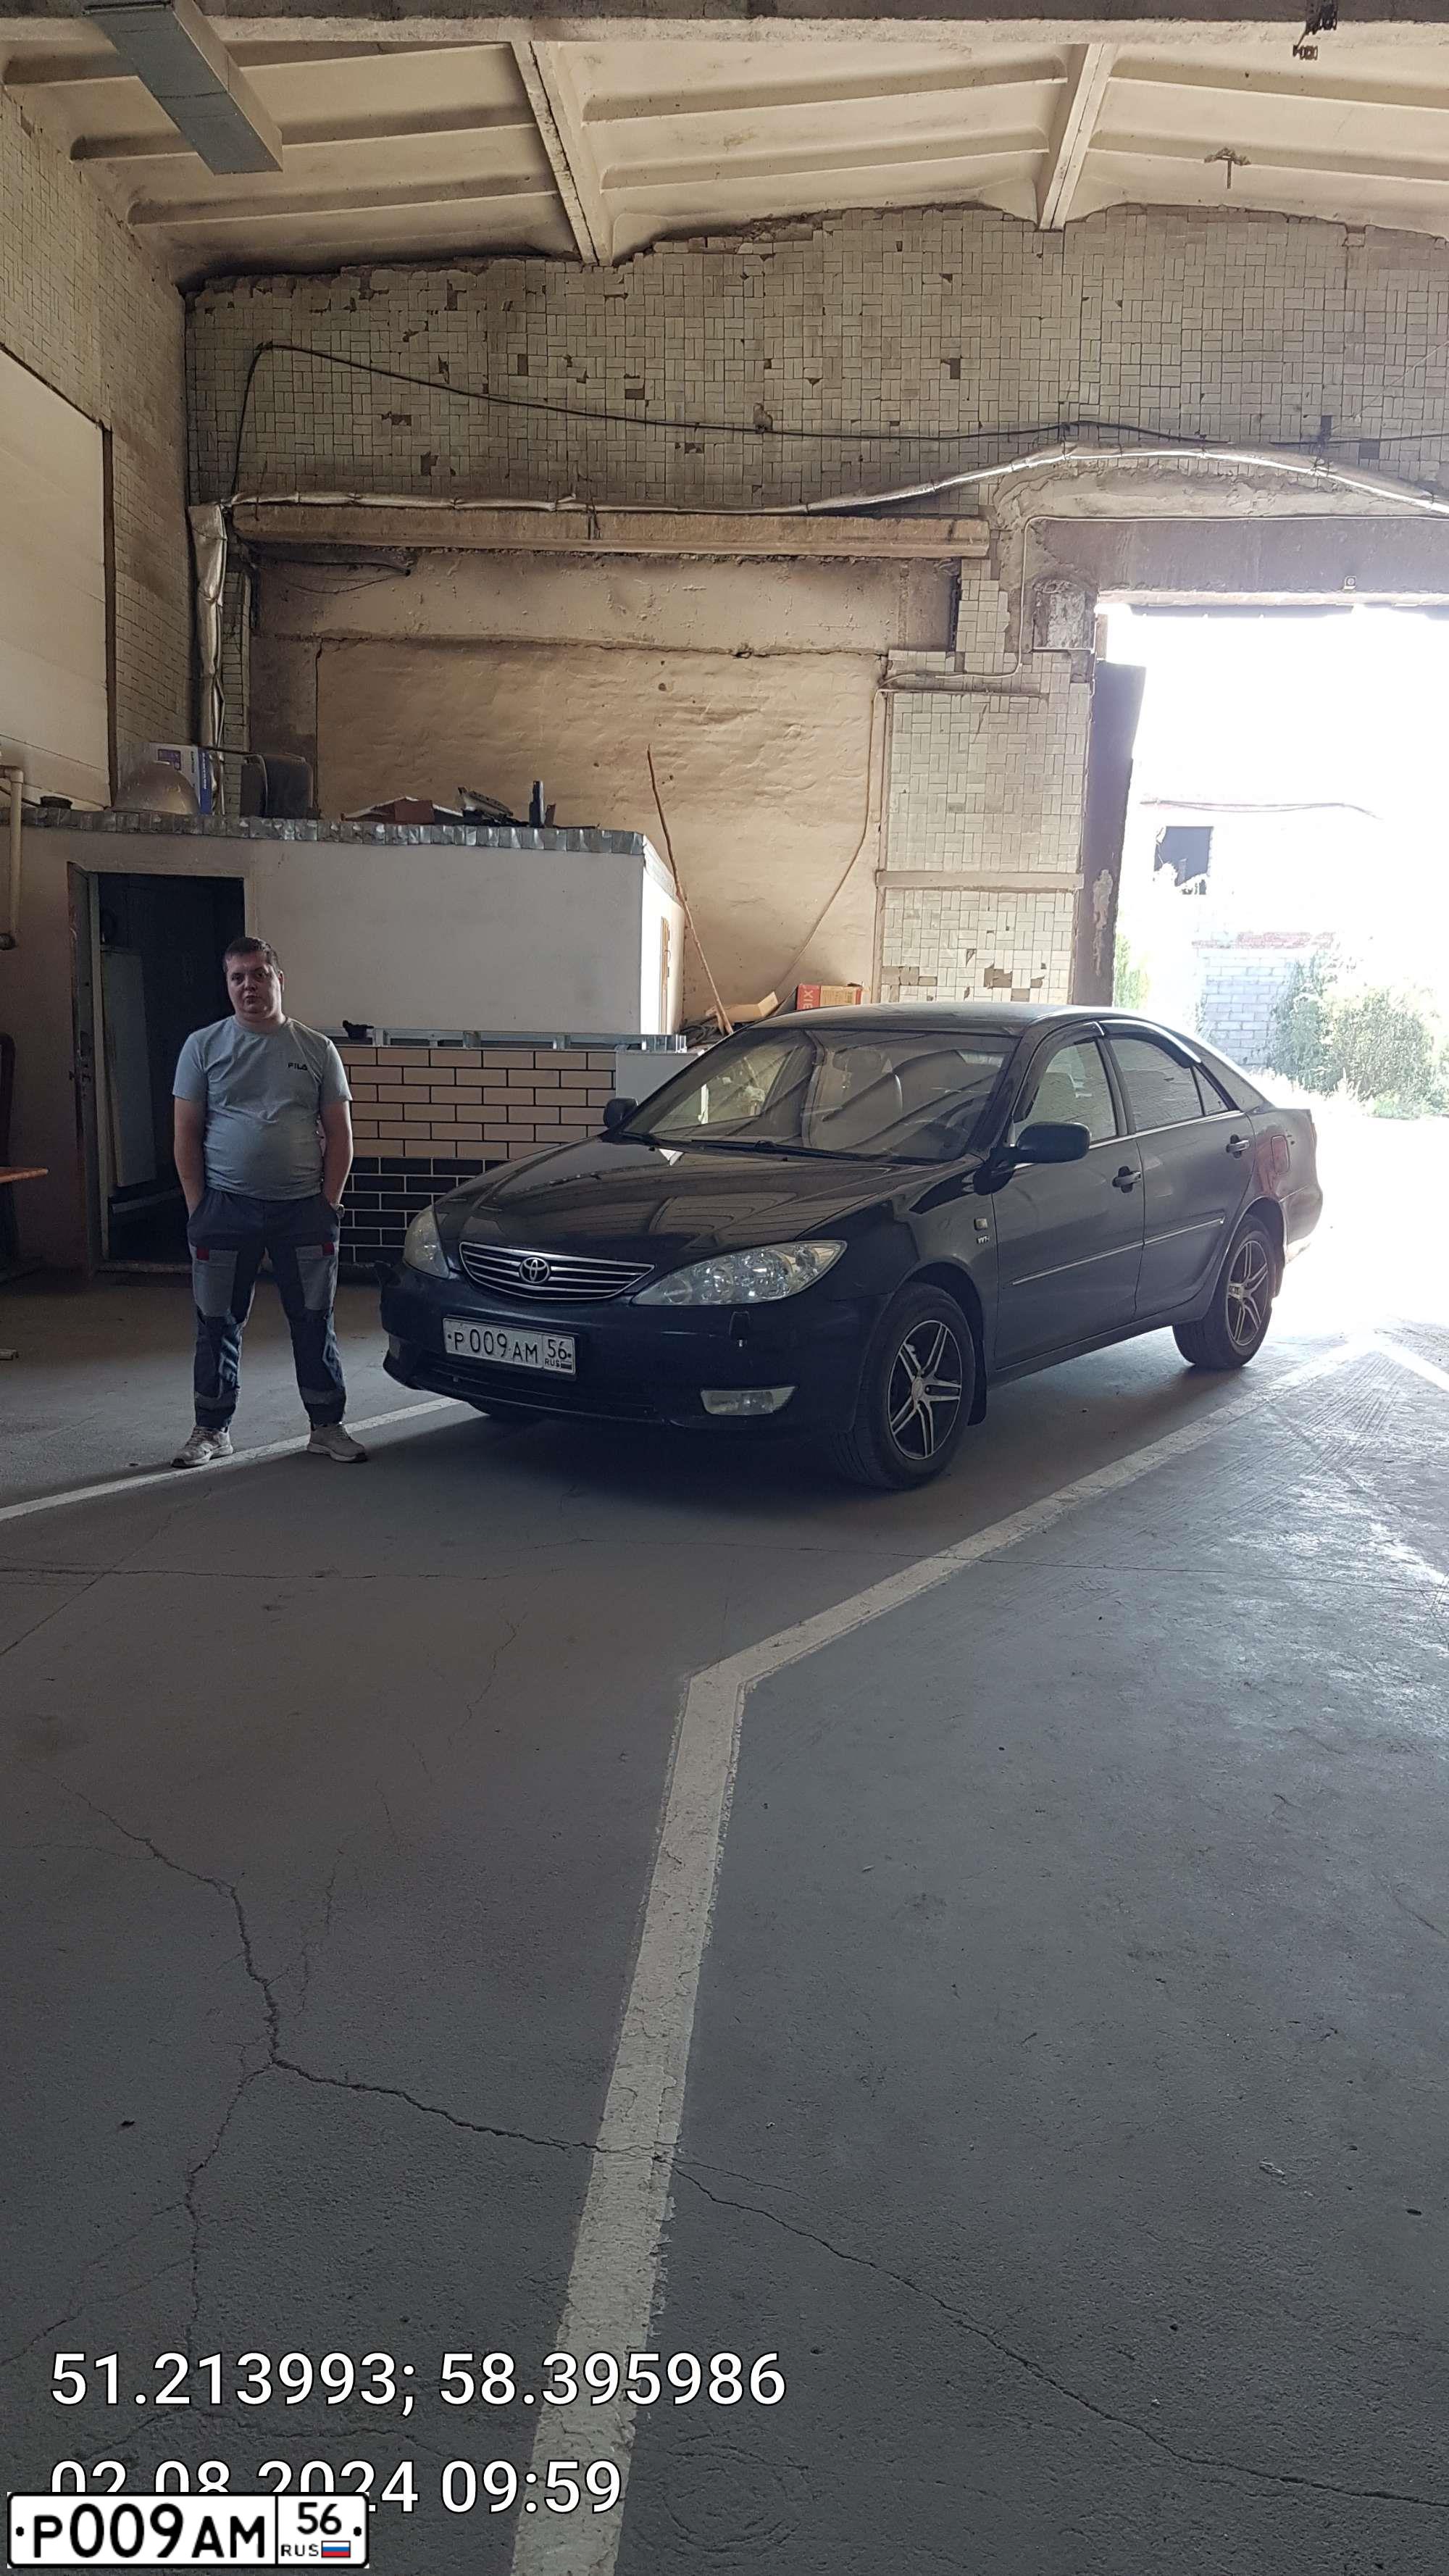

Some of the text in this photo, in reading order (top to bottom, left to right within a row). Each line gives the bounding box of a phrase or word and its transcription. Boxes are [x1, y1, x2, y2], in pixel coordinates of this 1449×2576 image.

[288, 1062, 308, 1071] FILA
[547, 1339, 567, 1360] 56
[545, 1358, 561, 1368] RUS
